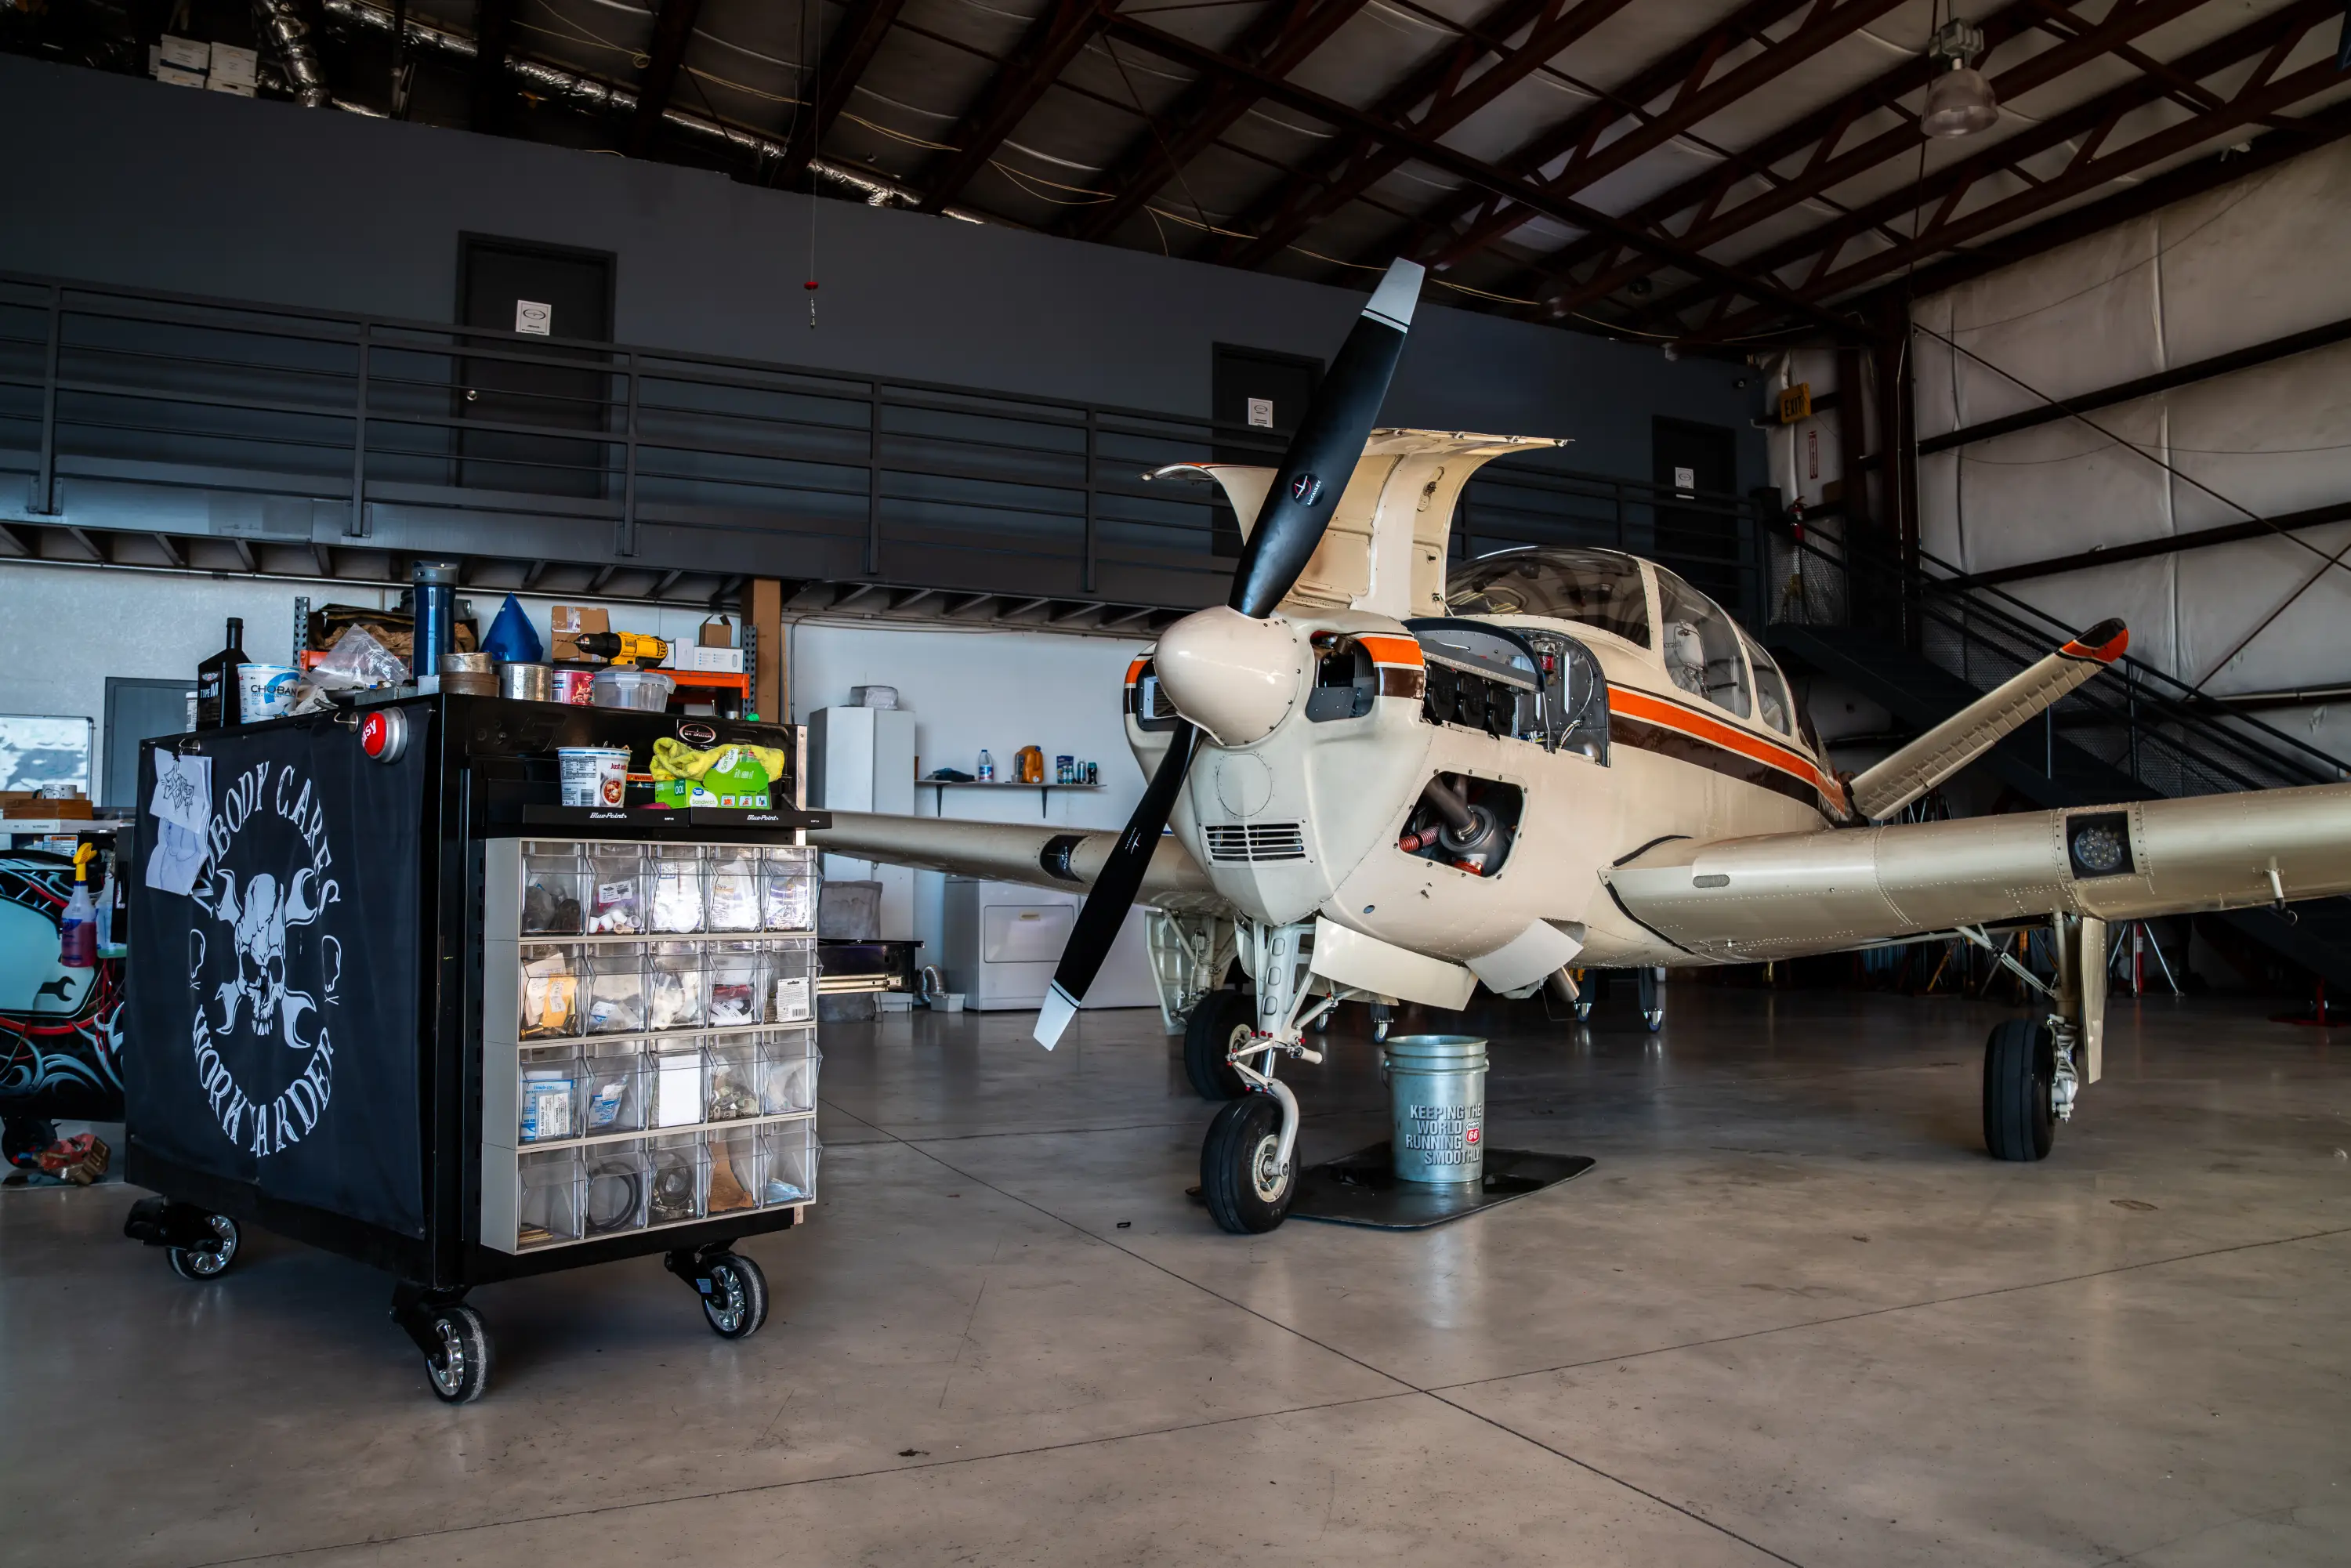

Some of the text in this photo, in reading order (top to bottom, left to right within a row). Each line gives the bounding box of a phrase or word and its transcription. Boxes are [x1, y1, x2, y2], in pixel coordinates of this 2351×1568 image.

[1784, 396, 1802, 418] EXIT
[200, 688, 211, 699] TYPE
[675, 784, 684, 795] 100
[277, 765, 341, 916] CARES
[193, 1004, 248, 1146] WORK
[1410, 1103, 1481, 1120] KEEPING THE
[1417, 1120, 1462, 1135] WORLD
[1468, 1130, 1479, 1140] 66
[1405, 1134, 1462, 1150] RUNNING
[1424, 1147, 1481, 1165] SMOOTHLY.
